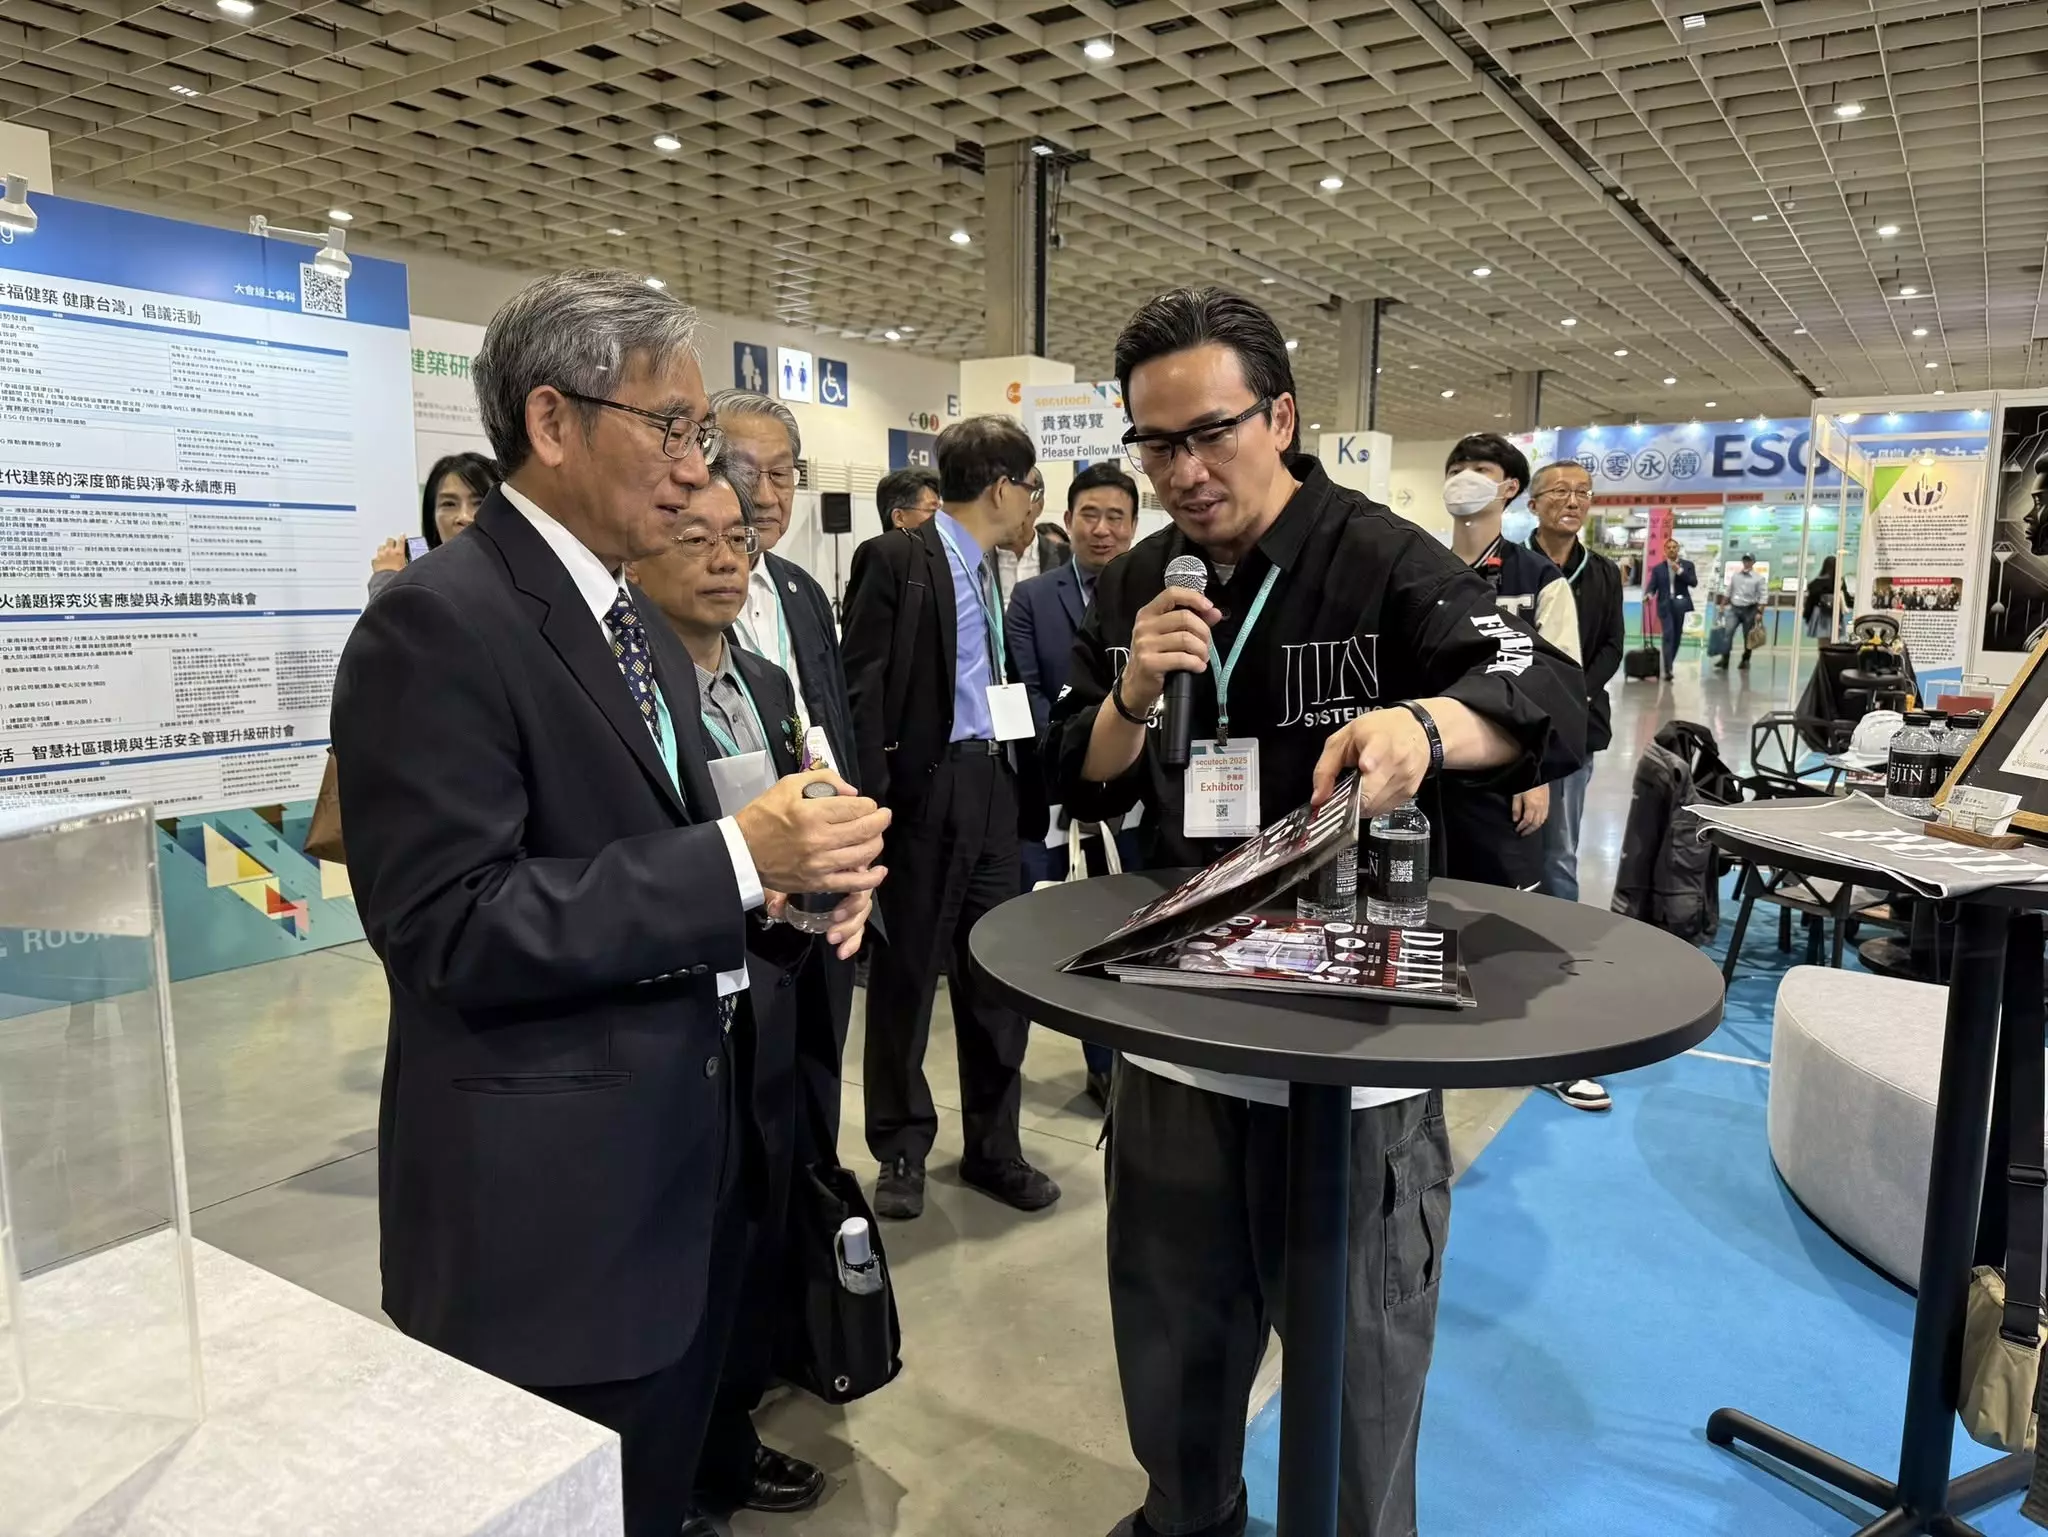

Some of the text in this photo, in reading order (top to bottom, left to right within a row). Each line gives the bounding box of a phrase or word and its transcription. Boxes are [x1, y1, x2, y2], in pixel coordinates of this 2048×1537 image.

[233, 283, 296, 302] 大會線上會刊
[1034, 394, 1091, 408] secutech
[1041, 414, 1104, 431] 貴賓導覽
[1041, 434, 1081, 445] VIP Tour
[1042, 447, 1074, 458] Please
[1077, 446, 1109, 457] Follow
[1338, 436, 1356, 464] K
[0, 592, 257, 610] 火議題探究災害應變與永續趨勢高峰會
[1303, 706, 1385, 728] SSTEM
[32, 724, 295, 761] 智慧社區環境與生活安全管理升級研討會
[1195, 757, 1248, 766] secutech 2025
[1200, 782, 1244, 792] Exhibitor
[1387, 929, 1444, 992] DEJIN
